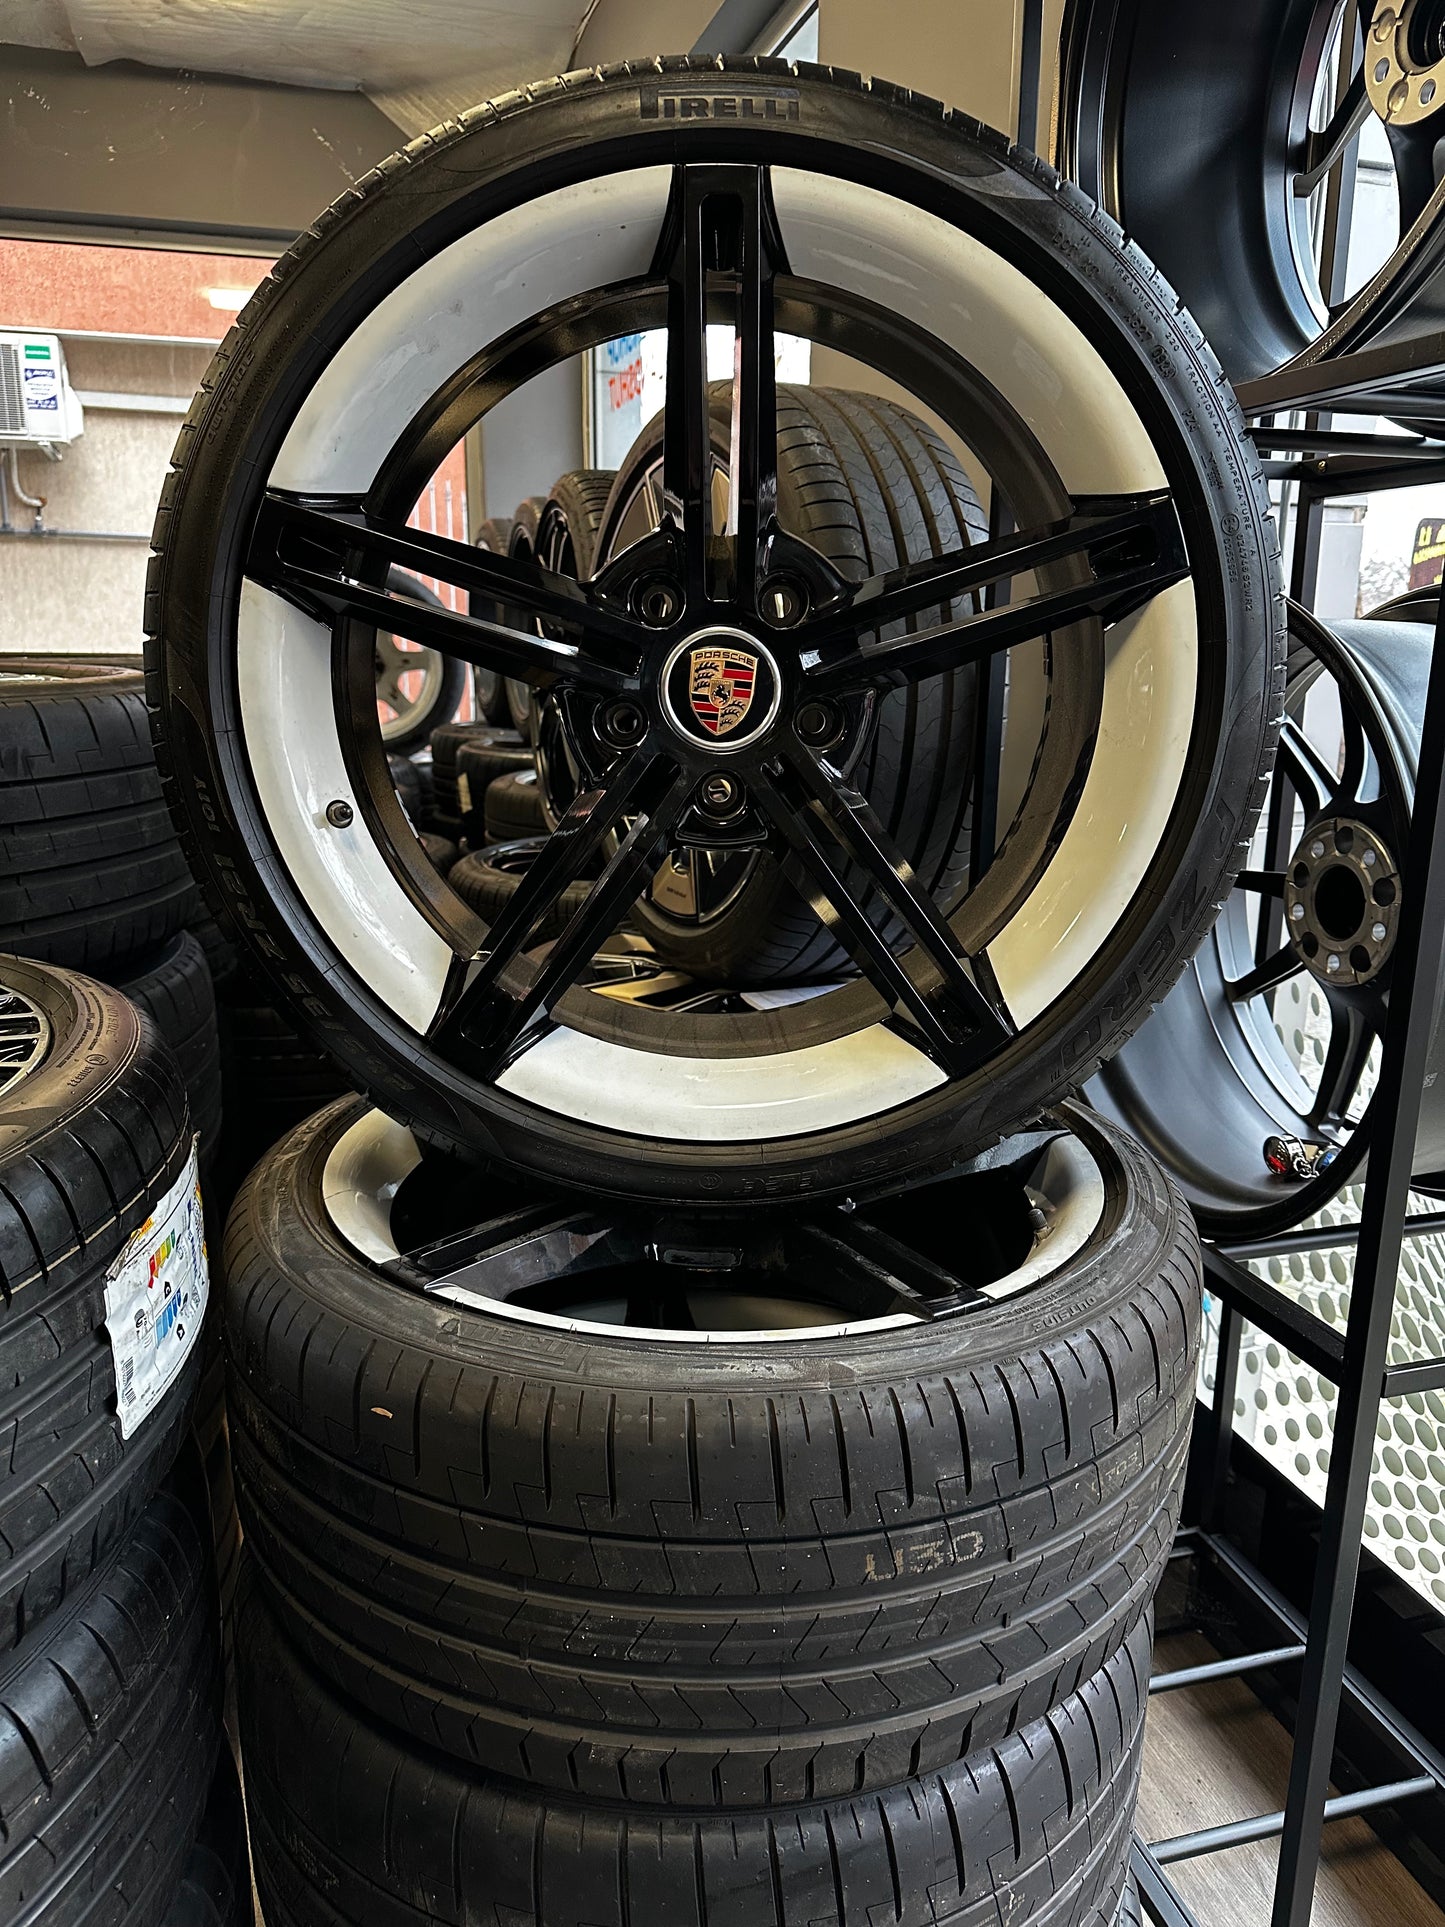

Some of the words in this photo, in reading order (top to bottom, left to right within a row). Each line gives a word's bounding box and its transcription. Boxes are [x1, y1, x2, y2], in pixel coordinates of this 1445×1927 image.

[640, 83, 799, 120] PIRELLI
[1112, 261, 1161, 323] TREADWEAR
[1165, 331, 1180, 352] 220
[1185, 364, 1216, 419] TRACTION
[1213, 422, 1222, 438] AA
[1223, 446, 1252, 531] TEMPERATURE
[695, 651, 754, 666] PORSCHE
[1060, 868, 1209, 1073] ZERO
